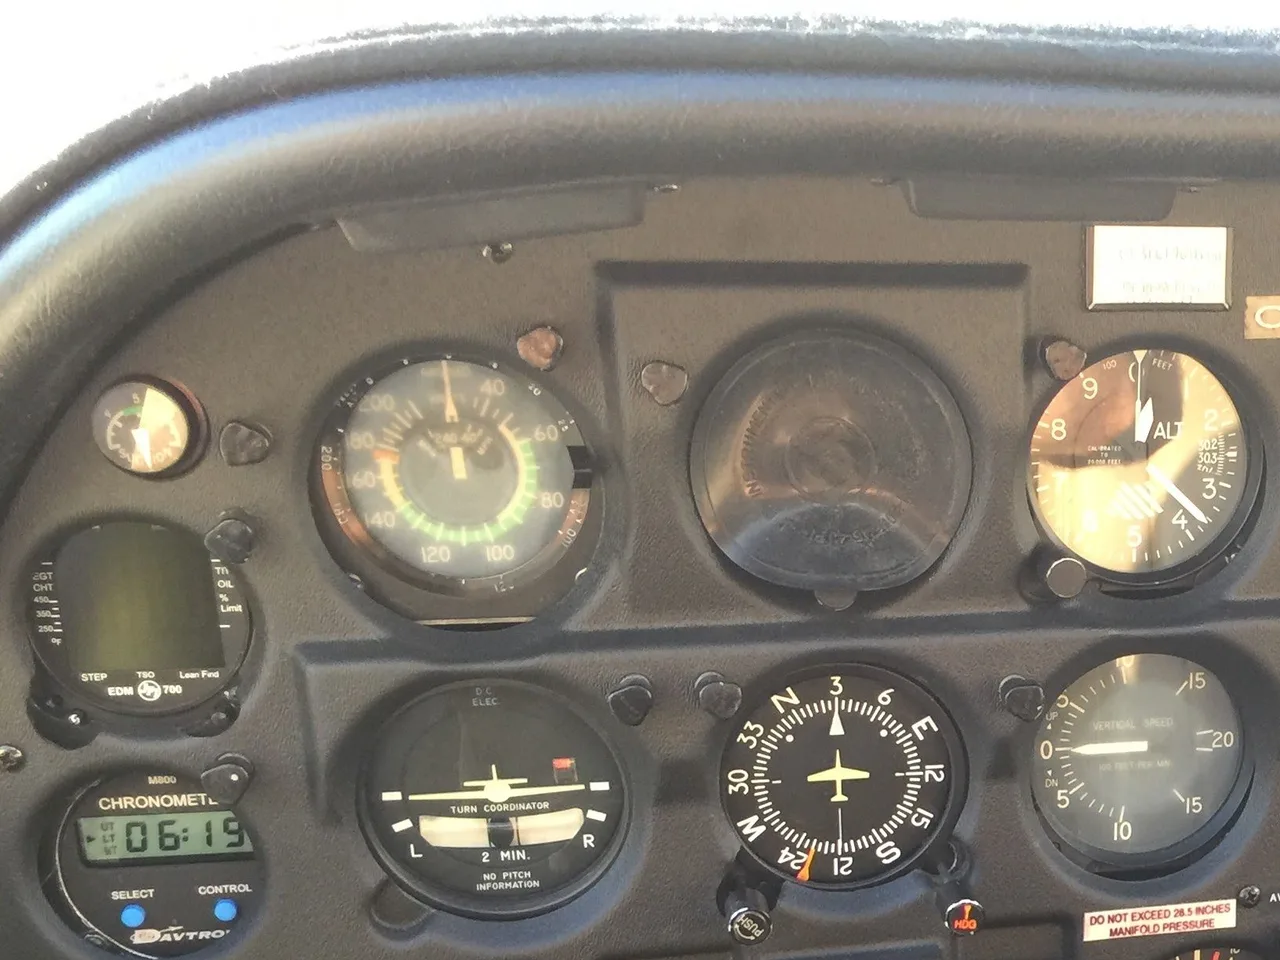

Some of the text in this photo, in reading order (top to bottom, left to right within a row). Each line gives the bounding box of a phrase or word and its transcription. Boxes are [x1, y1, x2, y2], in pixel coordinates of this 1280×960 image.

[1152, 358, 1173, 370] FEET
[1051, 419, 1066, 440] 8
[1154, 421, 1184, 439] ALT
[1202, 478, 1216, 499] 3
[422, 546, 450, 562] 120
[486, 544, 515, 562] 100
[218, 580, 234, 589] OIL
[221, 604, 242, 613] Limit
[81, 673, 107, 681] STEP
[180, 671, 199, 679] Lean
[108, 685, 182, 695] EDM 700
[831, 676, 843, 695] 3
[771, 687, 800, 714] N
[912, 716, 938, 740] E
[1093, 718, 1173, 730] VERTICAL SPEED
[925, 764, 944, 782] 12
[728, 769, 748, 794] 30
[451, 802, 549, 814] TURN COORDINATOR
[126, 817, 244, 852] 06:19
[584, 834, 595, 848] R
[411, 844, 422, 858] L
[482, 850, 530, 862] 2 MIN.
[876, 841, 901, 864] S
[484, 872, 530, 880] NO PITCH
[198, 884, 252, 895] CONTROL
[476, 880, 540, 890] INFORMATION
[112, 889, 154, 900] SELECT
[1090, 903, 1231, 926] DO NOT EXCEED 28.5 INCHES
[954, 919, 976, 929] HDG
[1109, 919, 1215, 937] MANIFOLD PRESSURE
